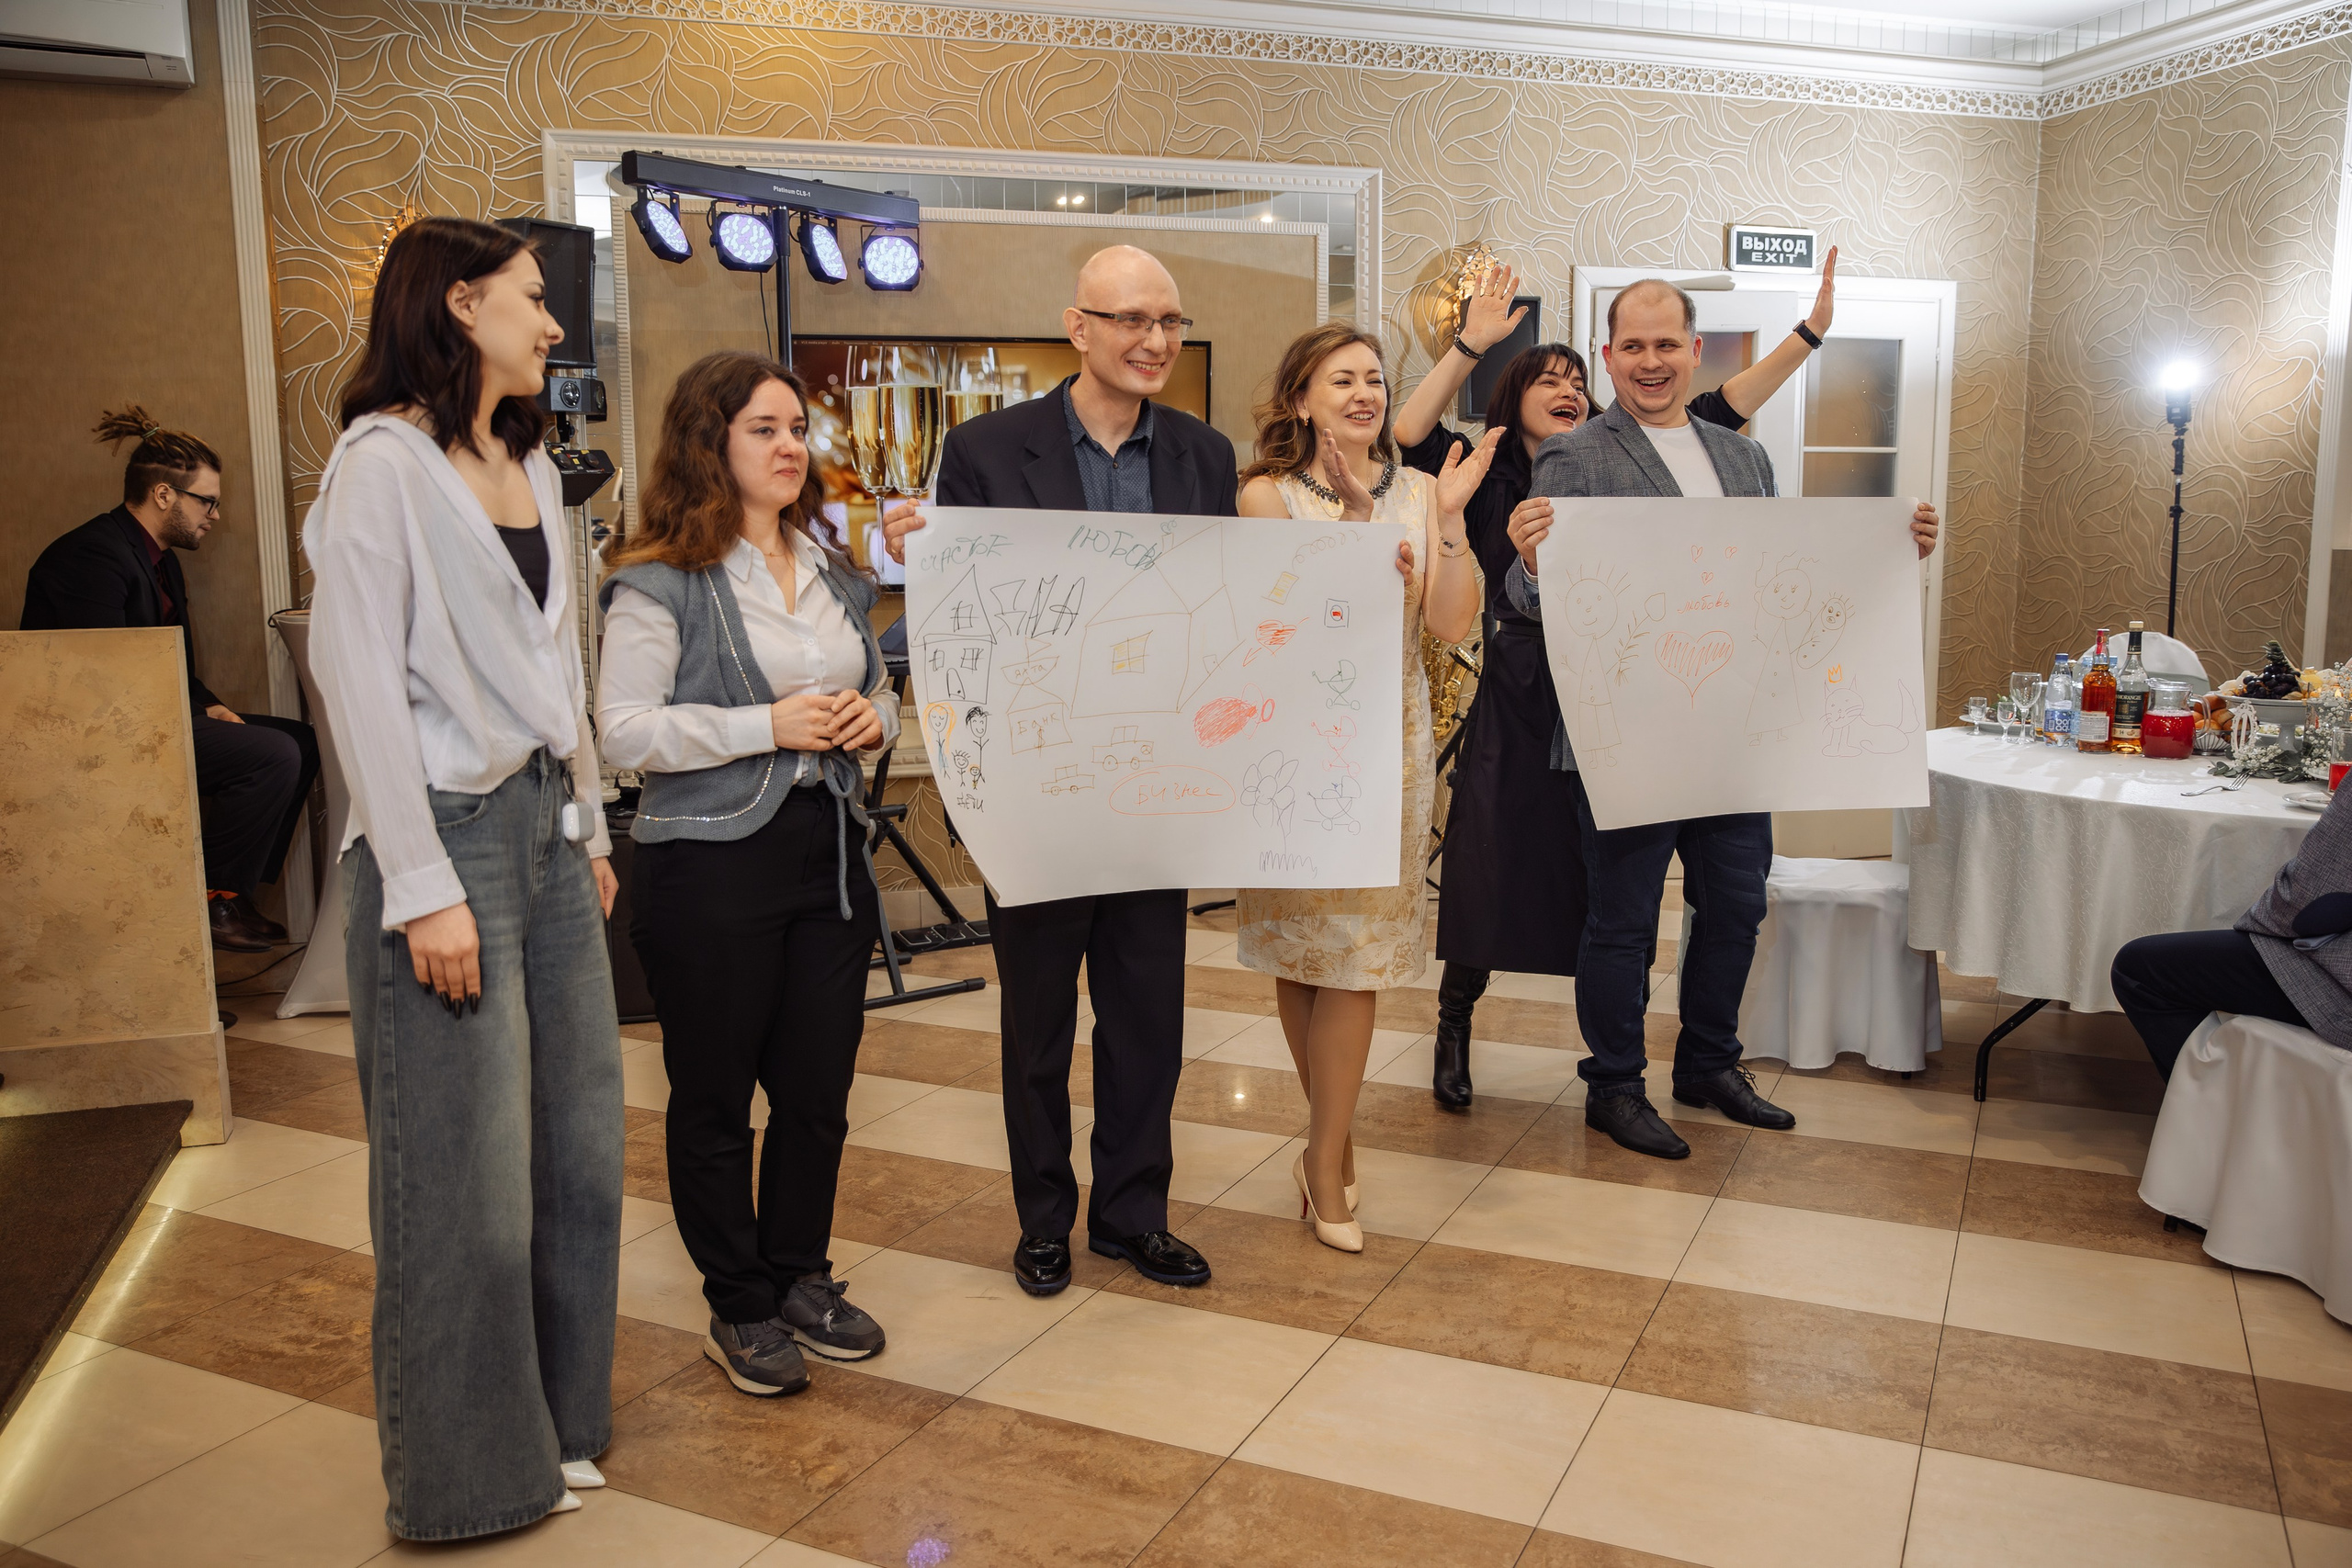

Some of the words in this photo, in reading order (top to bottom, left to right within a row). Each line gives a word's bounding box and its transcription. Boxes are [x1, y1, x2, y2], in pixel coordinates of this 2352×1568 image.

[773, 185, 796, 195] Platinum
[796, 189, 811, 197] CLS-1
[1742, 235, 1807, 255] ВЫХОД
[1751, 252, 1798, 264] EXIT
